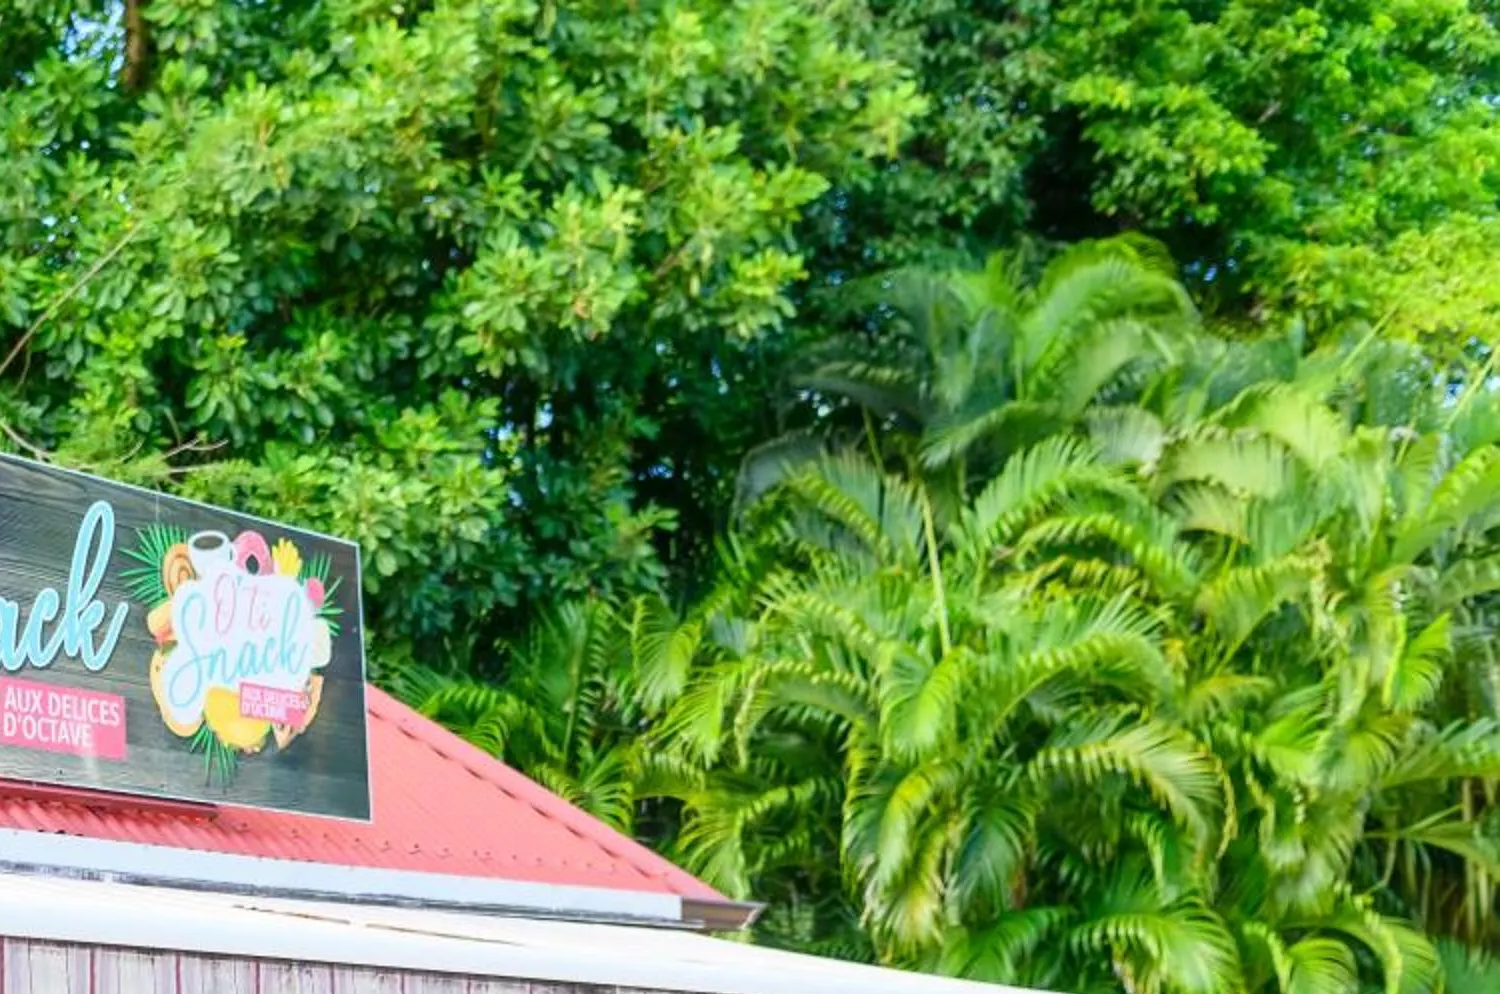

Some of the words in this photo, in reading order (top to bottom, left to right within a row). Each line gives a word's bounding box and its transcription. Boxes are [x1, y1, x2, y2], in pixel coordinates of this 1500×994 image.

[168, 590, 309, 709] Snack
[4, 686, 44, 714] AUX
[47, 691, 121, 727] DELICES
[3, 711, 94, 749] D'OCTAVE
